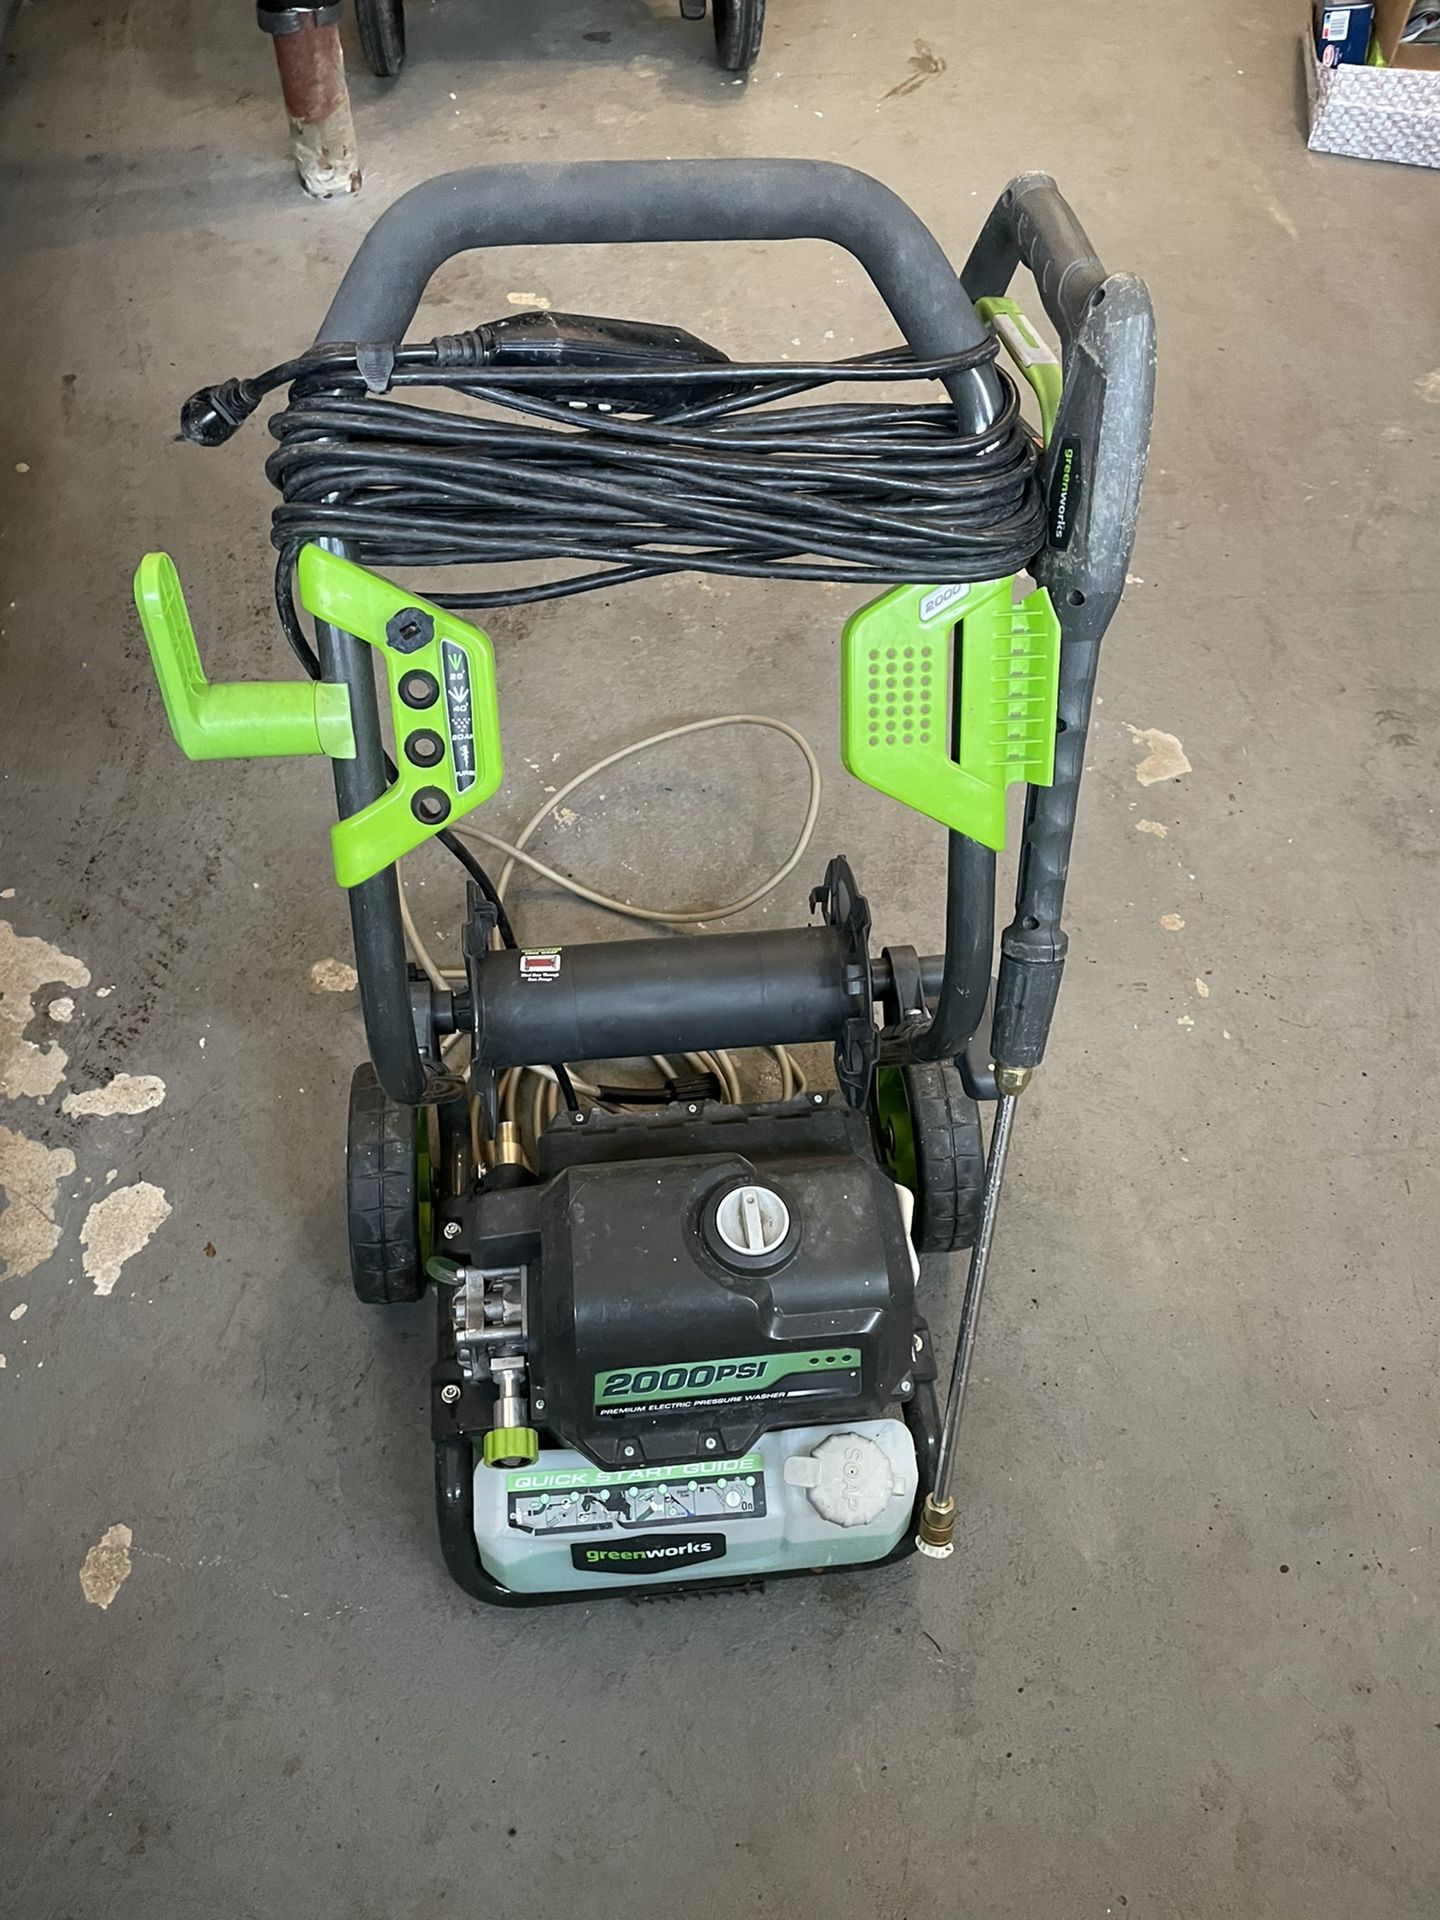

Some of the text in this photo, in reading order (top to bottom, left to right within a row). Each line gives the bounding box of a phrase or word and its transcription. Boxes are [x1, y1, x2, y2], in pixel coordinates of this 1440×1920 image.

[1055, 448, 1074, 538] greenworks
[925, 583, 962, 613] 2000
[602, 1361, 768, 1397] 2000PSI
[600, 1391, 786, 1416] PREMIUM ELECTRIC PRESSURE WASHER
[514, 1459, 755, 1488] QUICK START GUIDE
[843, 1447, 863, 1512] SOAP
[741, 1501, 753, 1511] On
[586, 1541, 712, 1563] greenworks
